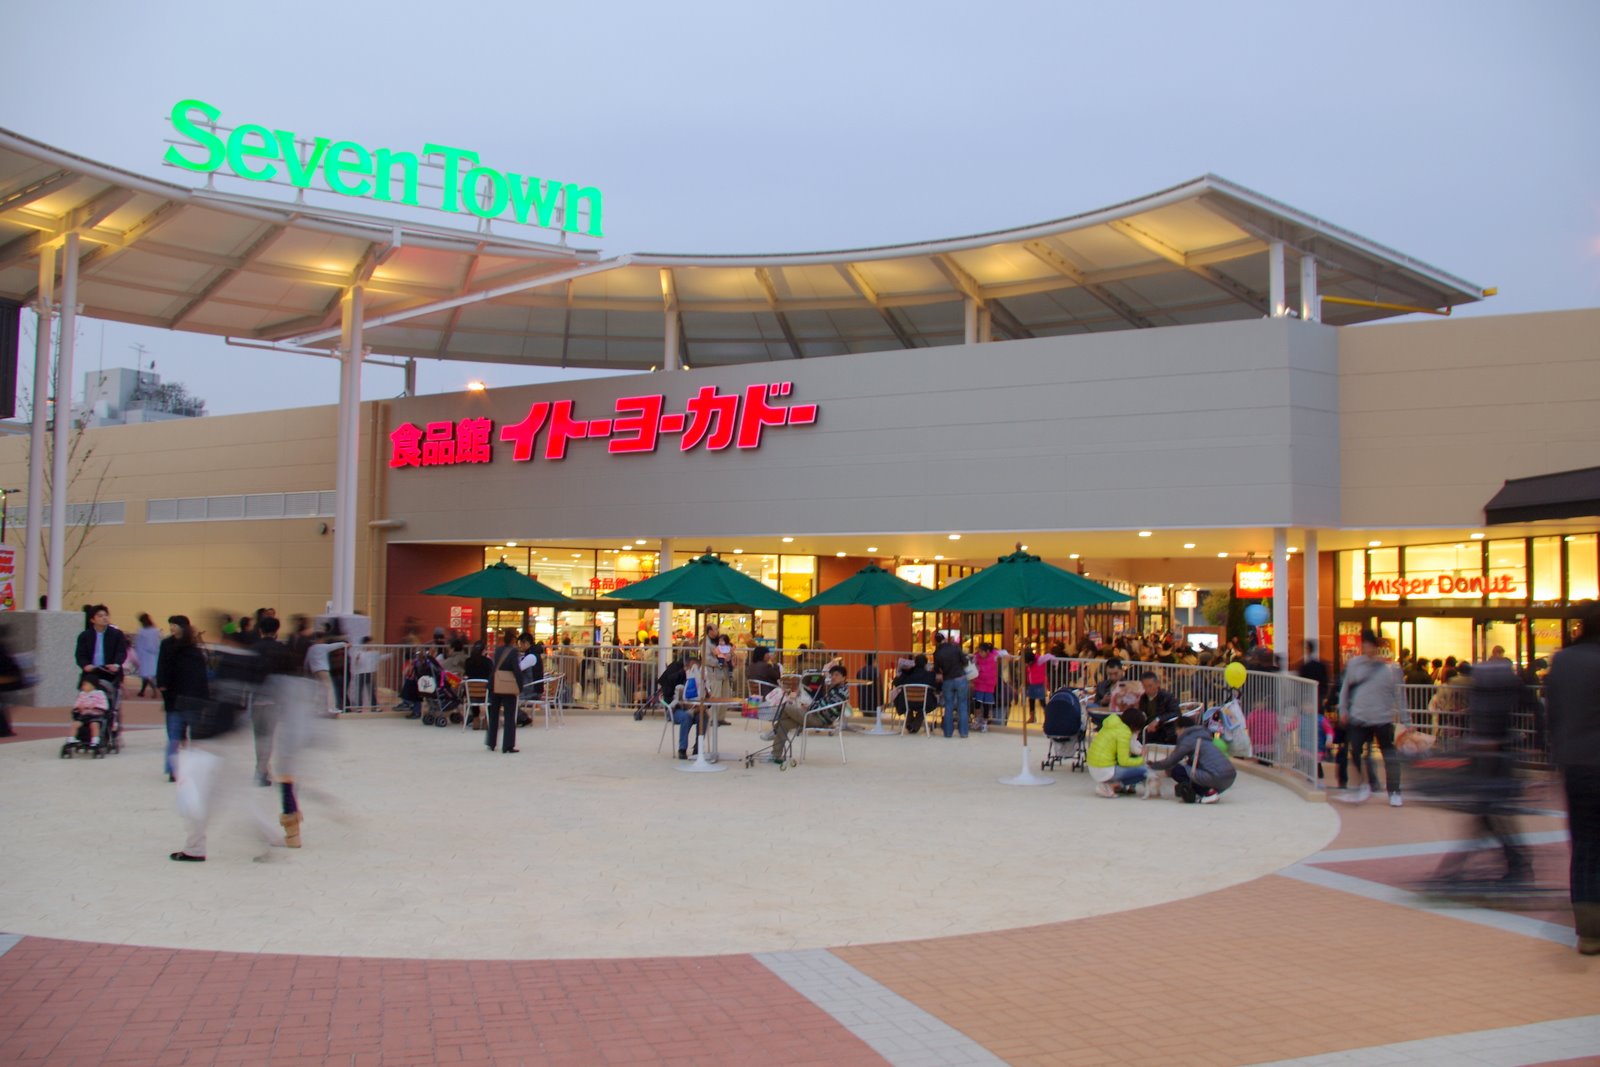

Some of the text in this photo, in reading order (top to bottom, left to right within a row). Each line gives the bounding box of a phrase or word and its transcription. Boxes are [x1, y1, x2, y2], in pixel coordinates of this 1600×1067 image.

[388, 383, 816, 468] 食品館 イトーヨーカドー
[1438, 574, 1517, 594] Donut
